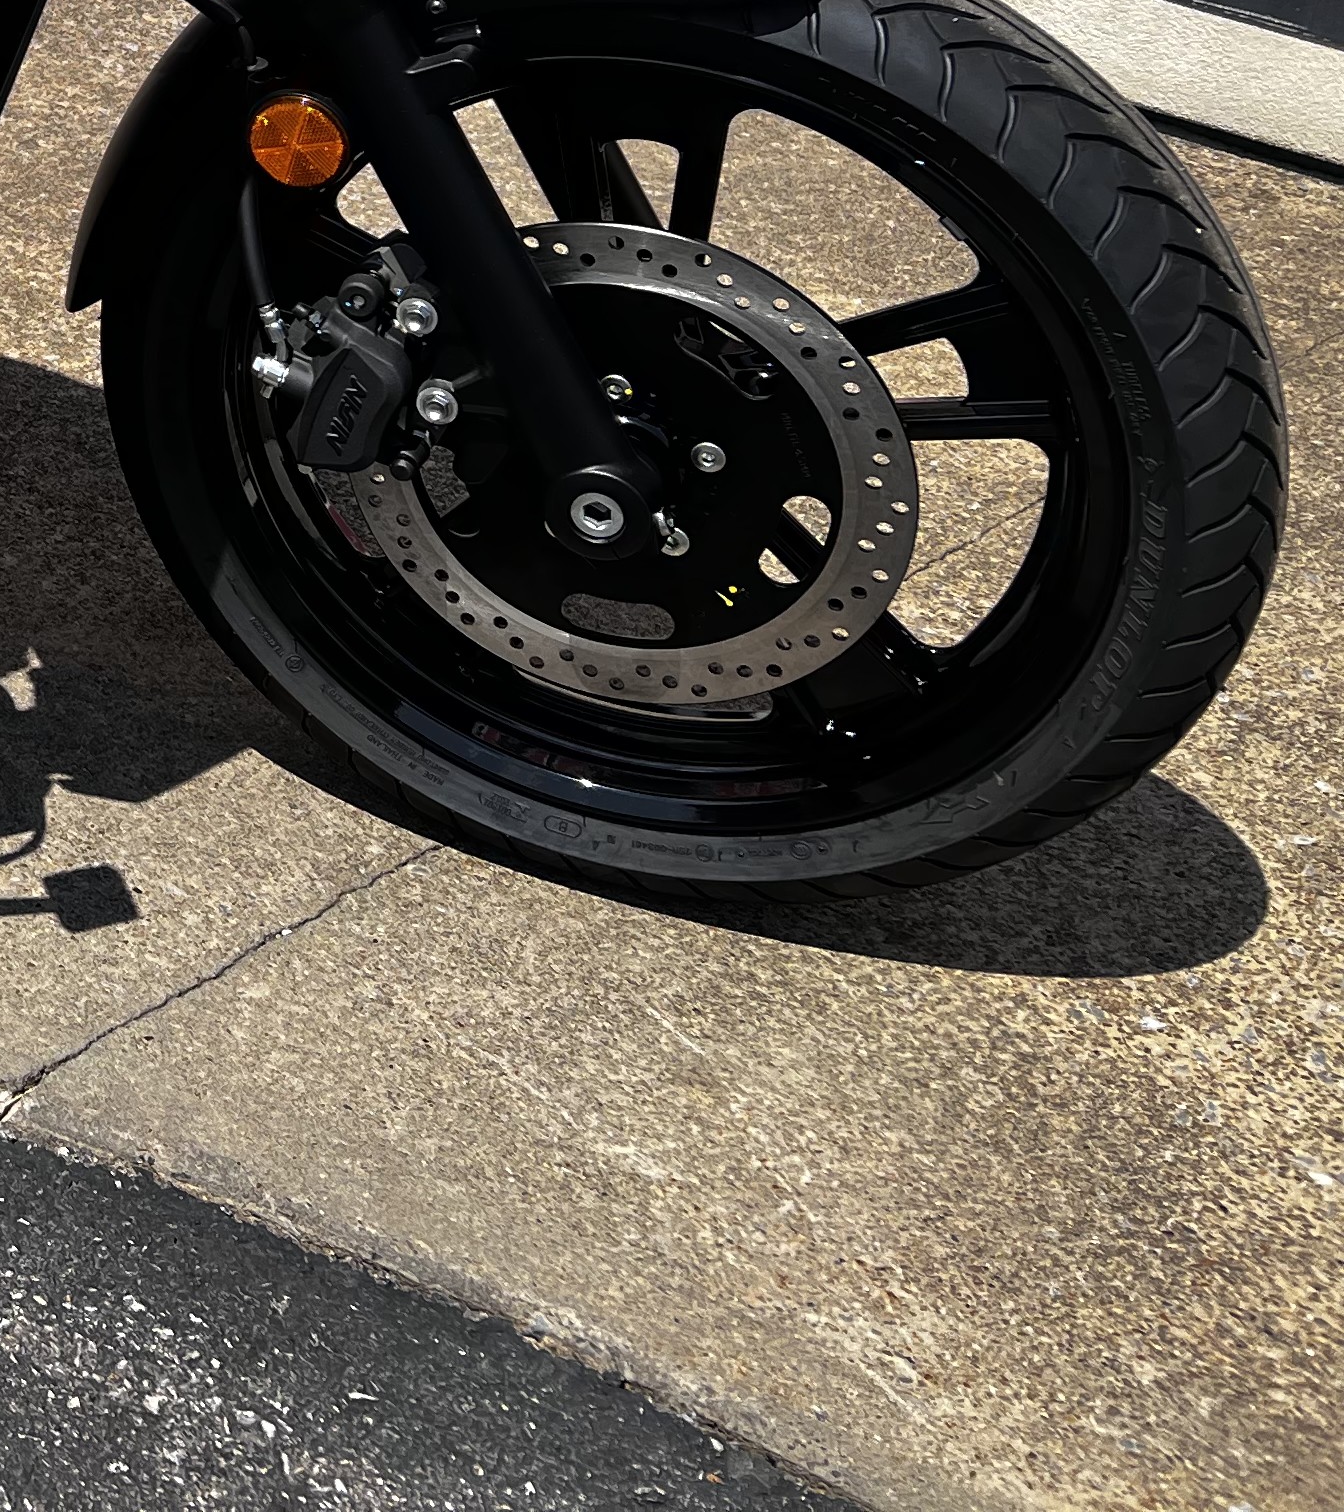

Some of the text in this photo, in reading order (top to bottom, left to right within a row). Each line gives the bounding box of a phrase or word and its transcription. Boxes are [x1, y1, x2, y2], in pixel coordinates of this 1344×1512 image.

[1090, 494, 1169, 713] DUNLOP
[366, 733, 404, 763] THAILAND
[422, 770, 446, 787] MADE
